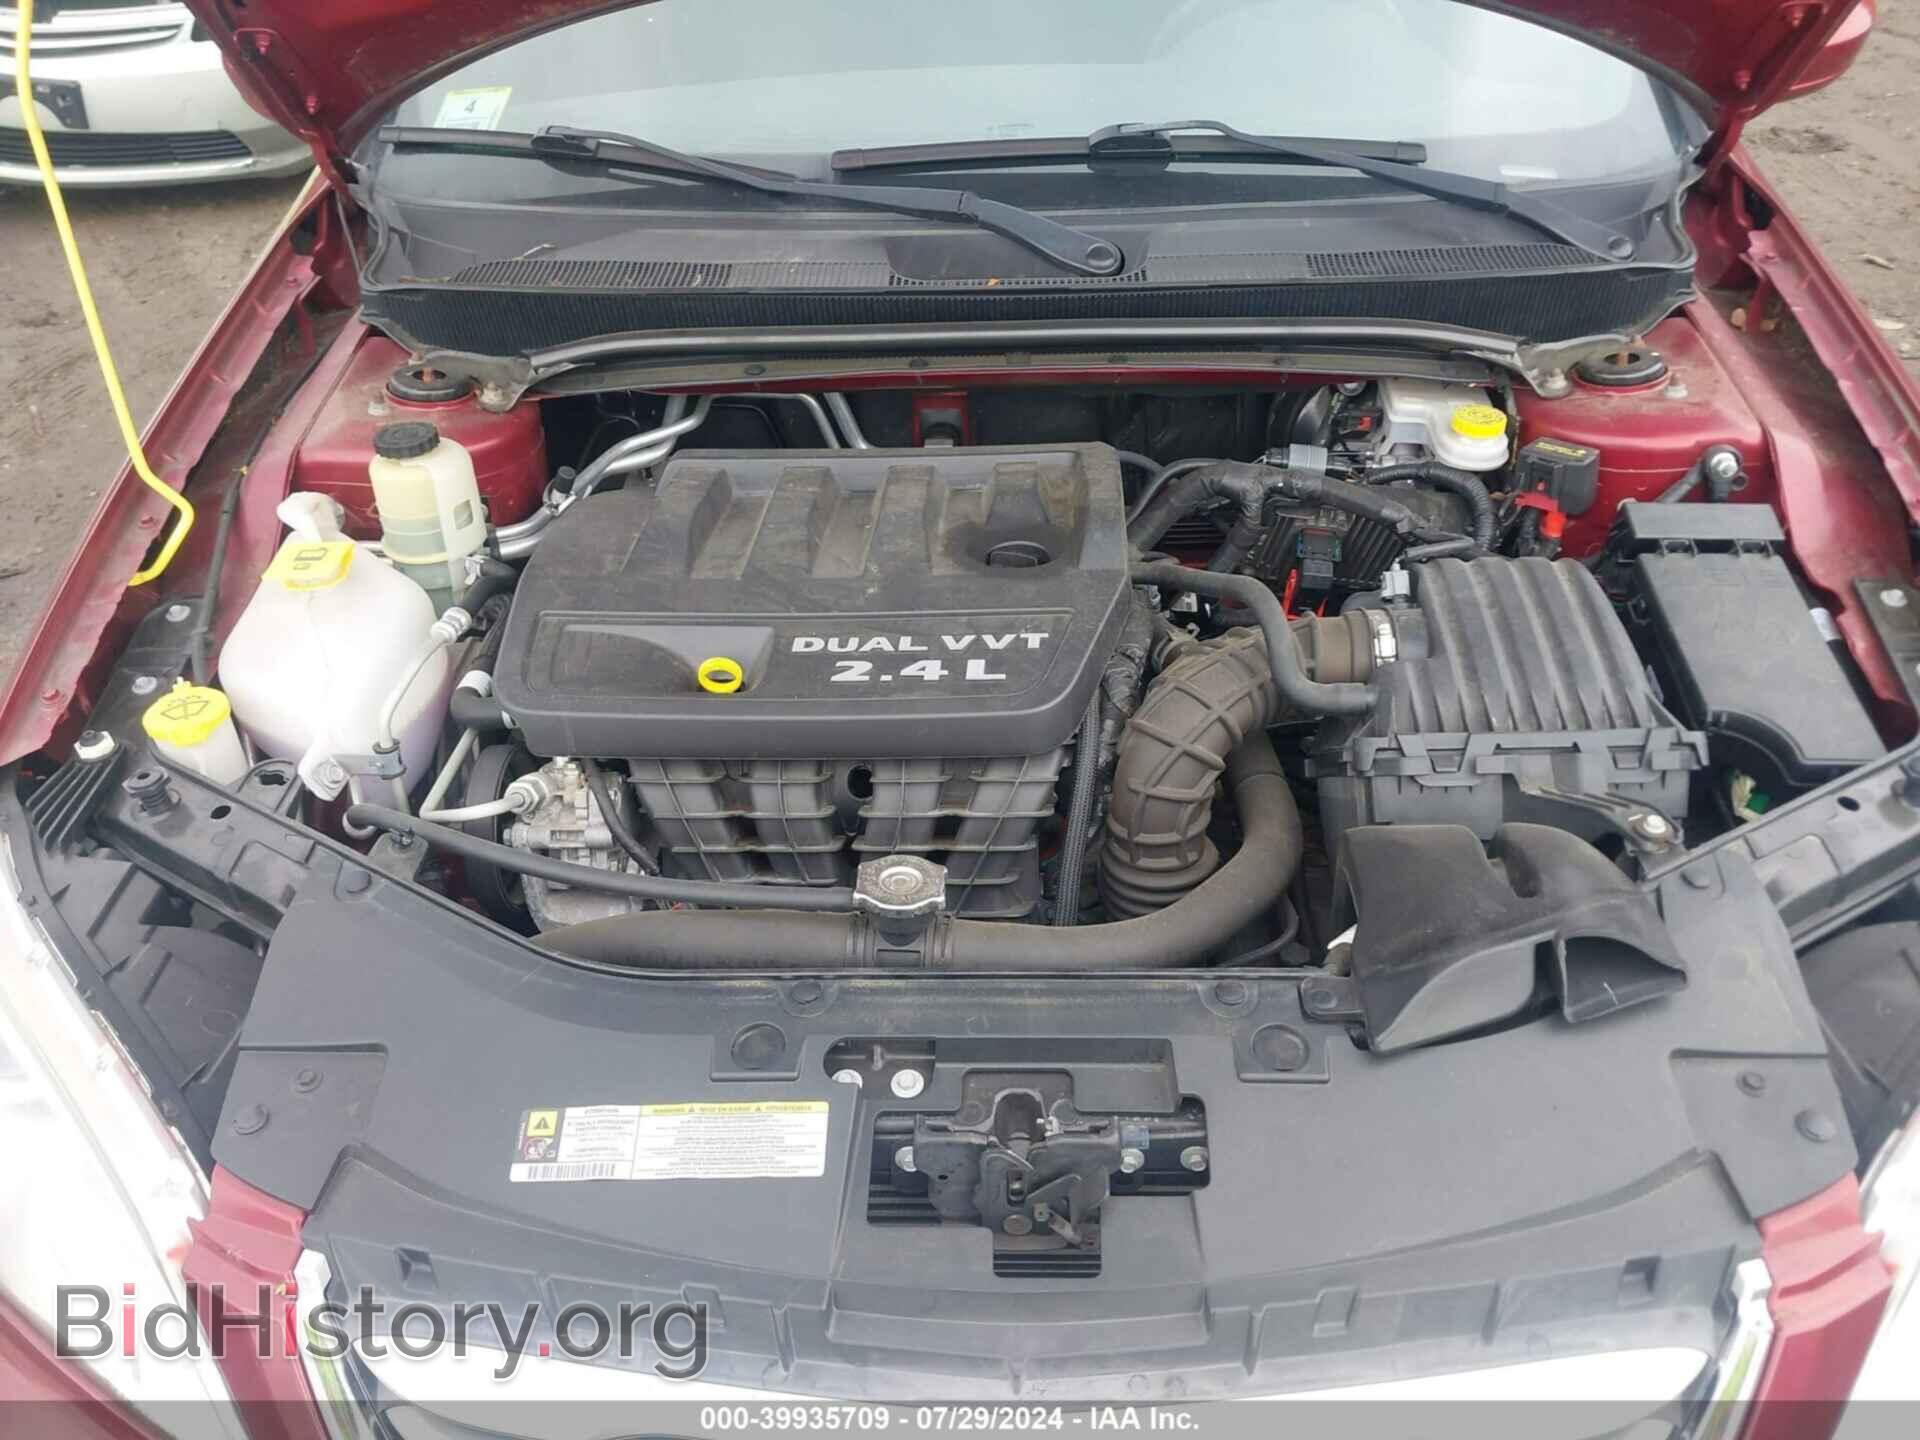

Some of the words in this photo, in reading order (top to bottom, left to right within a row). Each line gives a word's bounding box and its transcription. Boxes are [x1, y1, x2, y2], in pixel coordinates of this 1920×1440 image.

[791, 636, 929, 652] DUAL
[941, 632, 1050, 650] VVT
[830, 659, 949, 682] 2.4
[965, 659, 1007, 681] L
